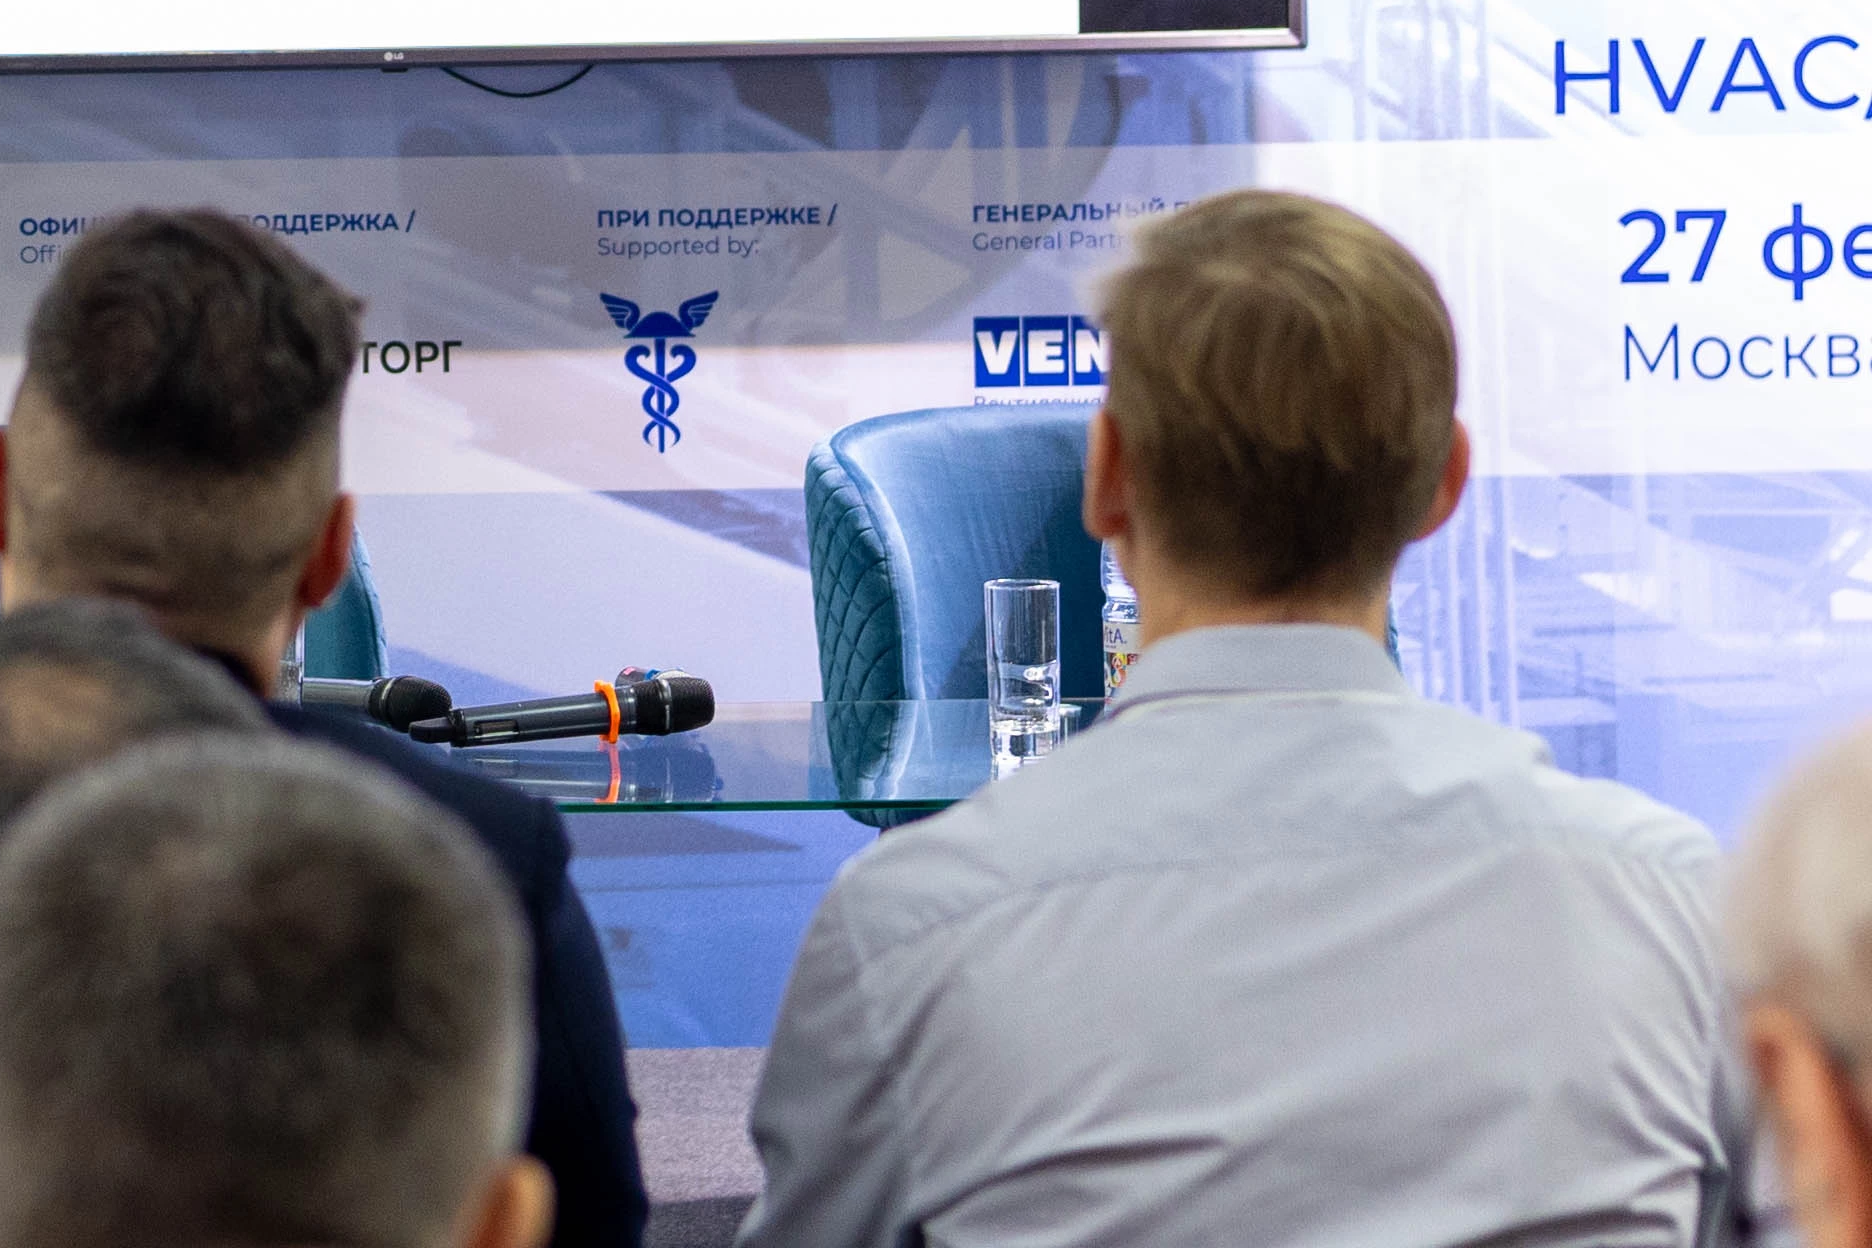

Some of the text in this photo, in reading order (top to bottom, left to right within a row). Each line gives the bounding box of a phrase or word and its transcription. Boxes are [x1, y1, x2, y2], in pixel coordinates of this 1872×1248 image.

[1554, 35, 1872, 120] HVAC
[597, 209, 650, 228] ПРИ
[658, 206, 821, 230] ПОДДЕРЖКЕ
[597, 235, 720, 260] Supported
[972, 231, 1062, 252] General
[1619, 208, 1727, 284] 27
[1624, 322, 1872, 382] Москв
